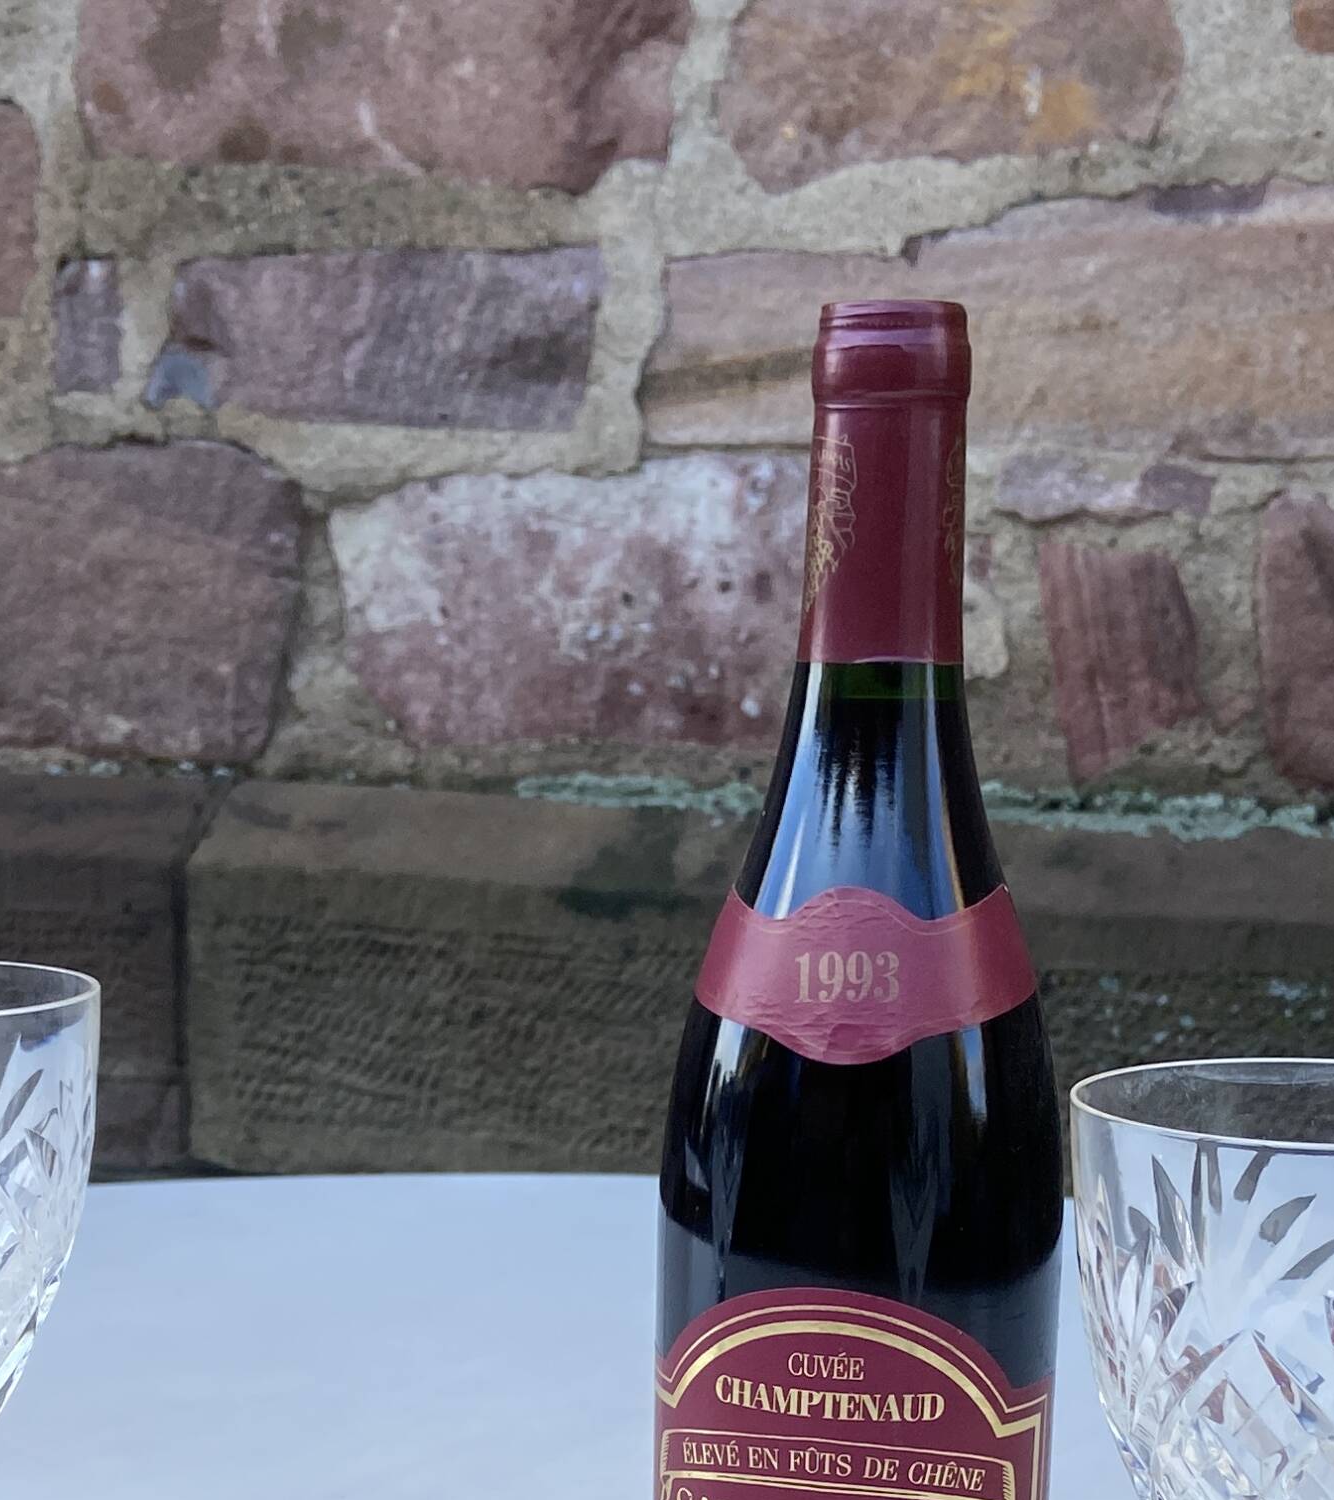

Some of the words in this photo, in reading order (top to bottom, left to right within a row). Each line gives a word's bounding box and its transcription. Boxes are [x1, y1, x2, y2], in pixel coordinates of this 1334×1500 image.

[794, 950, 900, 1003] 1993
[787, 1351, 865, 1381] CUVÉE
[715, 1374, 946, 1422] CHAMPTENAUD
[682, 1437, 740, 1467] ÉLEVÉ
[747, 1446, 779, 1470] EN
[789, 1446, 852, 1477] FÛTS
[863, 1456, 900, 1482] DE
[908, 1460, 986, 1492] CHÊNE
